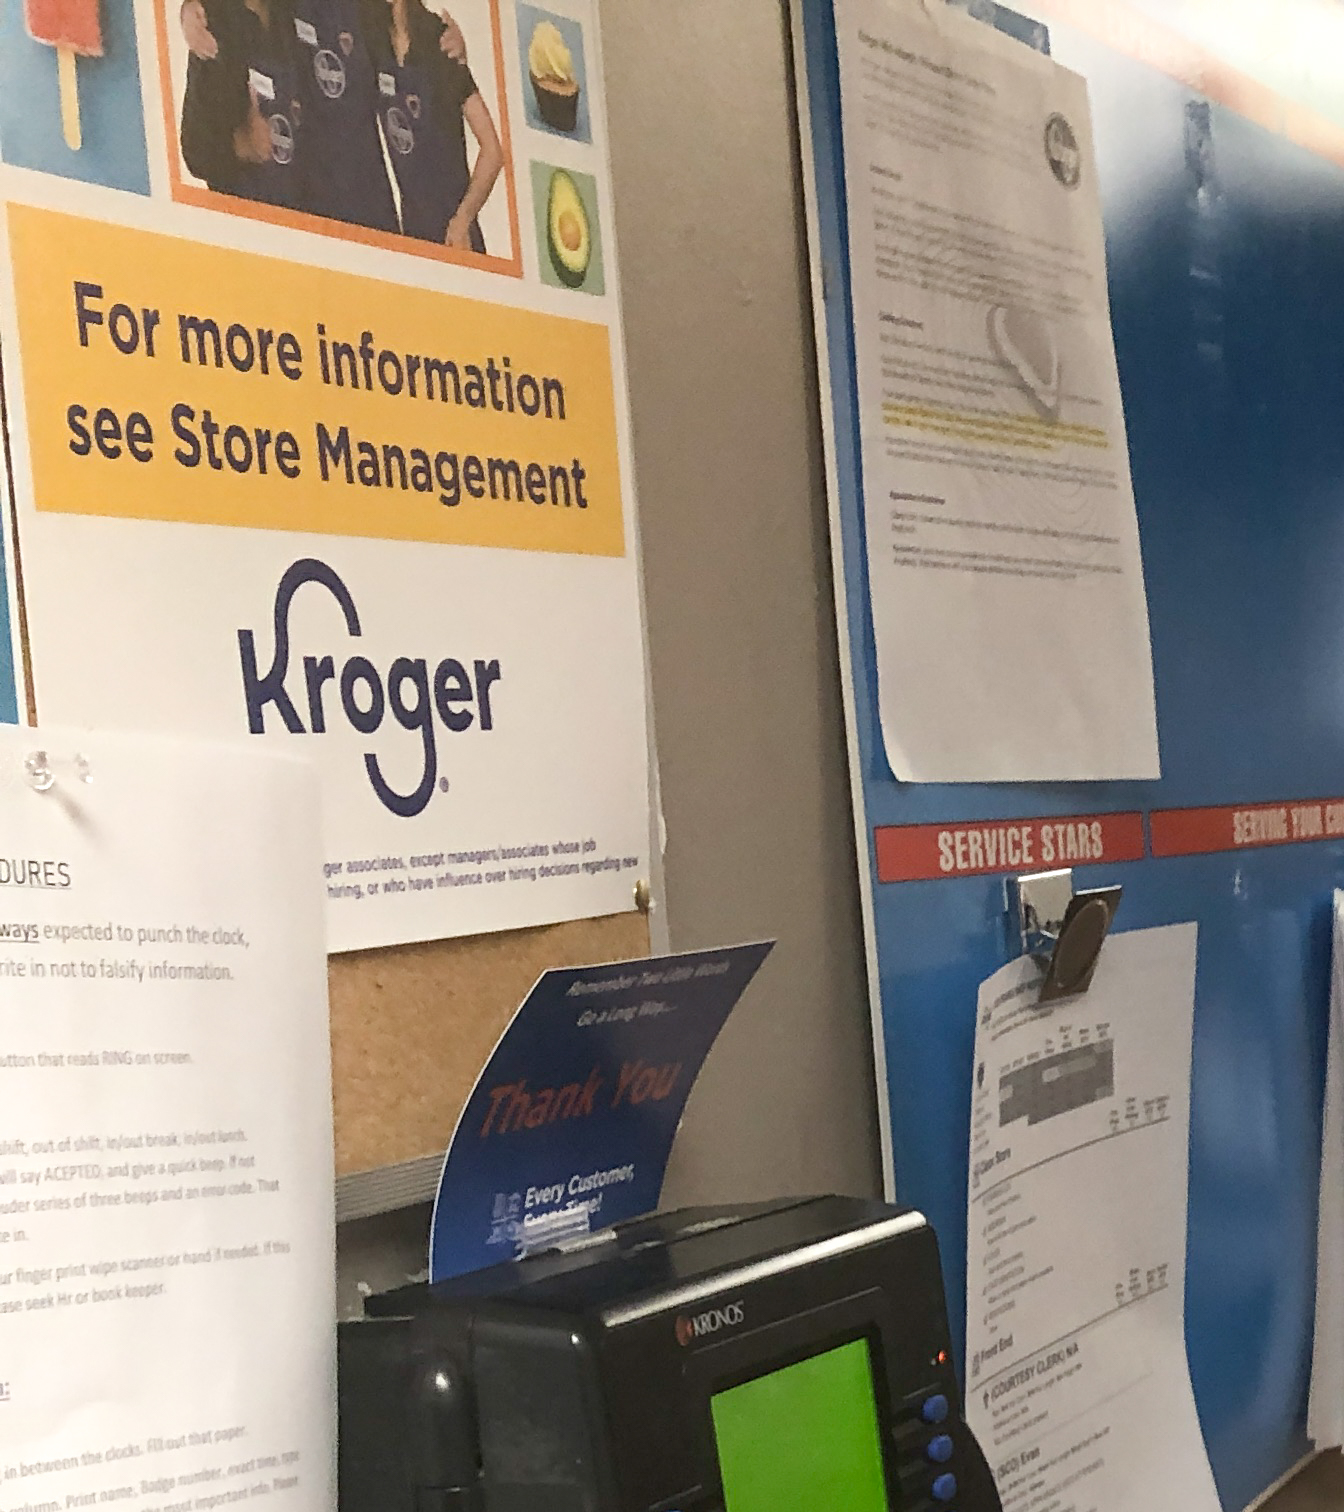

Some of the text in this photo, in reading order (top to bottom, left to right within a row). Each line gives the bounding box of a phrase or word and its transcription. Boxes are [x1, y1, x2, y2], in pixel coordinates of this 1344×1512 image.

[74, 280, 566, 420] For more information
[67, 402, 588, 509] see Store Management
[238, 558, 500, 817] Kroger
[347, 857, 407, 873] associates,
[410, 853, 444, 867] except
[552, 841, 579, 854] whose
[938, 821, 1103, 872] SERVICE STARS
[328, 883, 363, 899] hiring,
[367, 884, 378, 894] or
[382, 878, 405, 893] who
[408, 876, 433, 890] have
[436, 872, 482, 887] influence
[485, 871, 506, 883] over
[509, 868, 536, 881] hiring
[538, 864, 579, 877] decisions
[582, 858, 619, 875] regarding
[44, 922, 112, 943] expected
[117, 925, 133, 941] to
[138, 924, 181, 945] punch
[187, 925, 208, 943] the
[213, 926, 249, 949] clock,
[30, 957, 234, 982] in not to falsify information.
[38, 1052, 65, 1066] that
[102, 1050, 132, 1065] RING
[481, 1060, 683, 1138] Thank You
[32, 1139, 54, 1153] out
[21, 1171, 40, 1185] say
[107, 1162, 129, 1178] and
[132, 1163, 155, 1180] give
[525, 1163, 635, 1209] Every Customer,
[33, 1194, 71, 1211] series
[73, 1192, 87, 1209] of
[89, 1190, 121, 1206] three
[16, 1267, 52, 1285] finger
[56, 1264, 85, 1282] print
[120, 1256, 165, 1272] scanner
[26, 1294, 54, 1310] seek
[92, 1285, 122, 1302] book
[692, 1299, 745, 1337] KRONOS
[4, 1464, 17, 1480] in
[20, 1455, 79, 1477] between
[81, 1451, 102, 1466] the
[65, 1492, 96, 1508] Print
